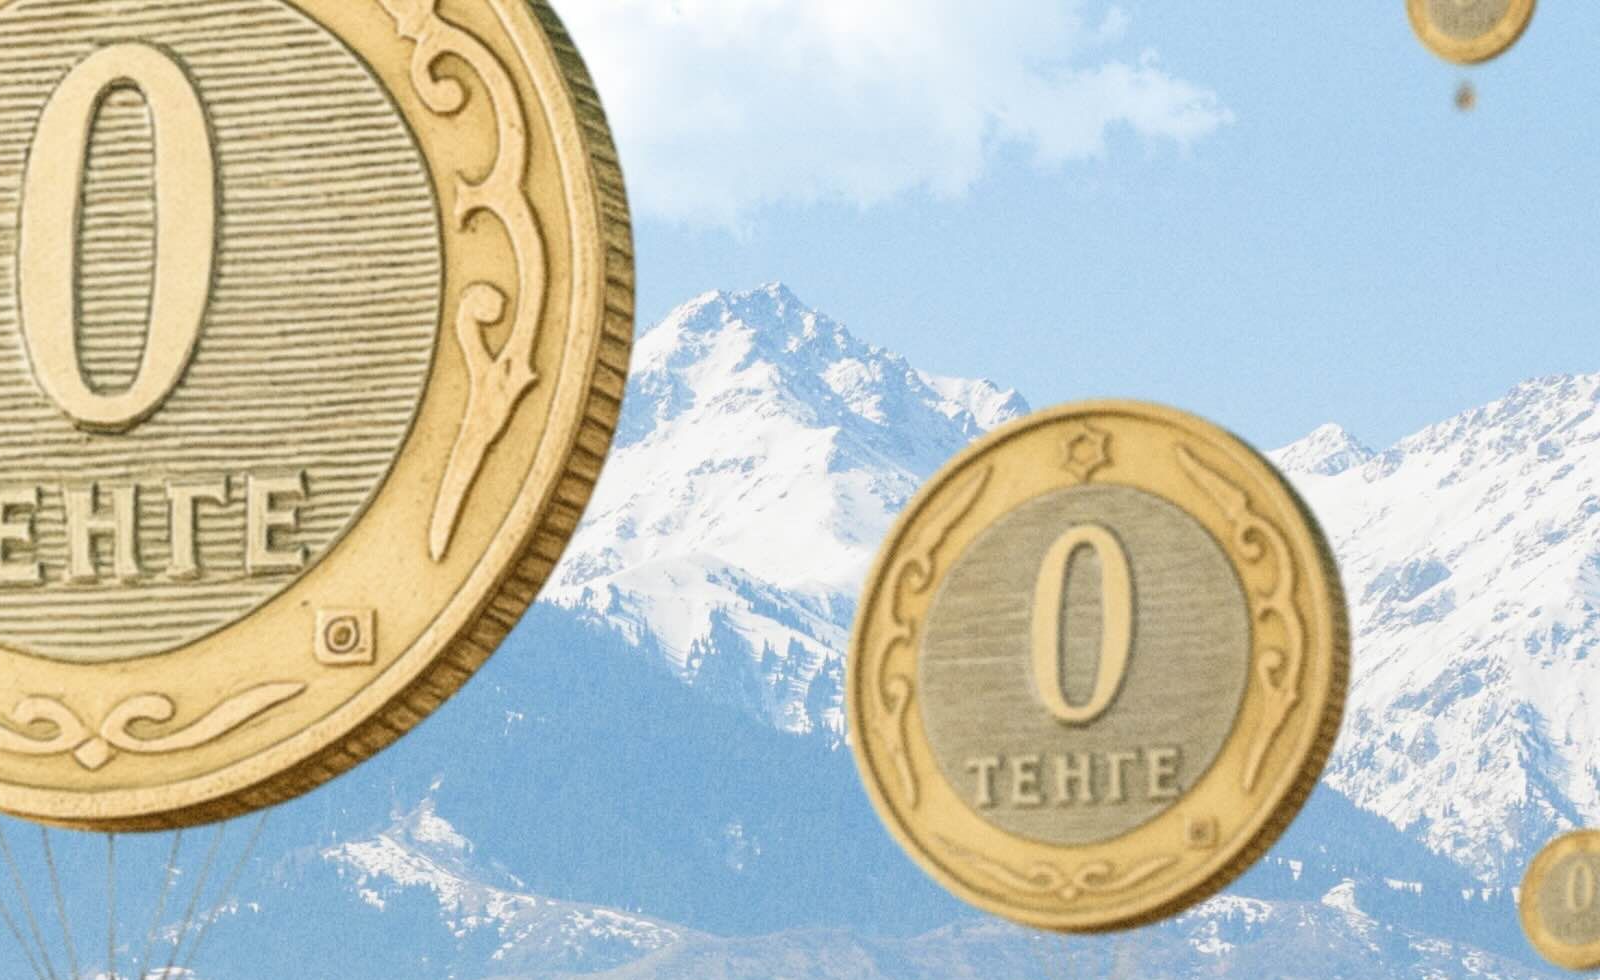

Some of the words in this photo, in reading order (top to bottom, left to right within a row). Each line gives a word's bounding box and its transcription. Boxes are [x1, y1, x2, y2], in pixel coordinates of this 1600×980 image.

[19, 39, 216, 430] 0
[1032, 523, 1135, 726] 0
[968, 748, 1183, 804] ТЕНГЕ
[1566, 861, 1594, 911] 0
